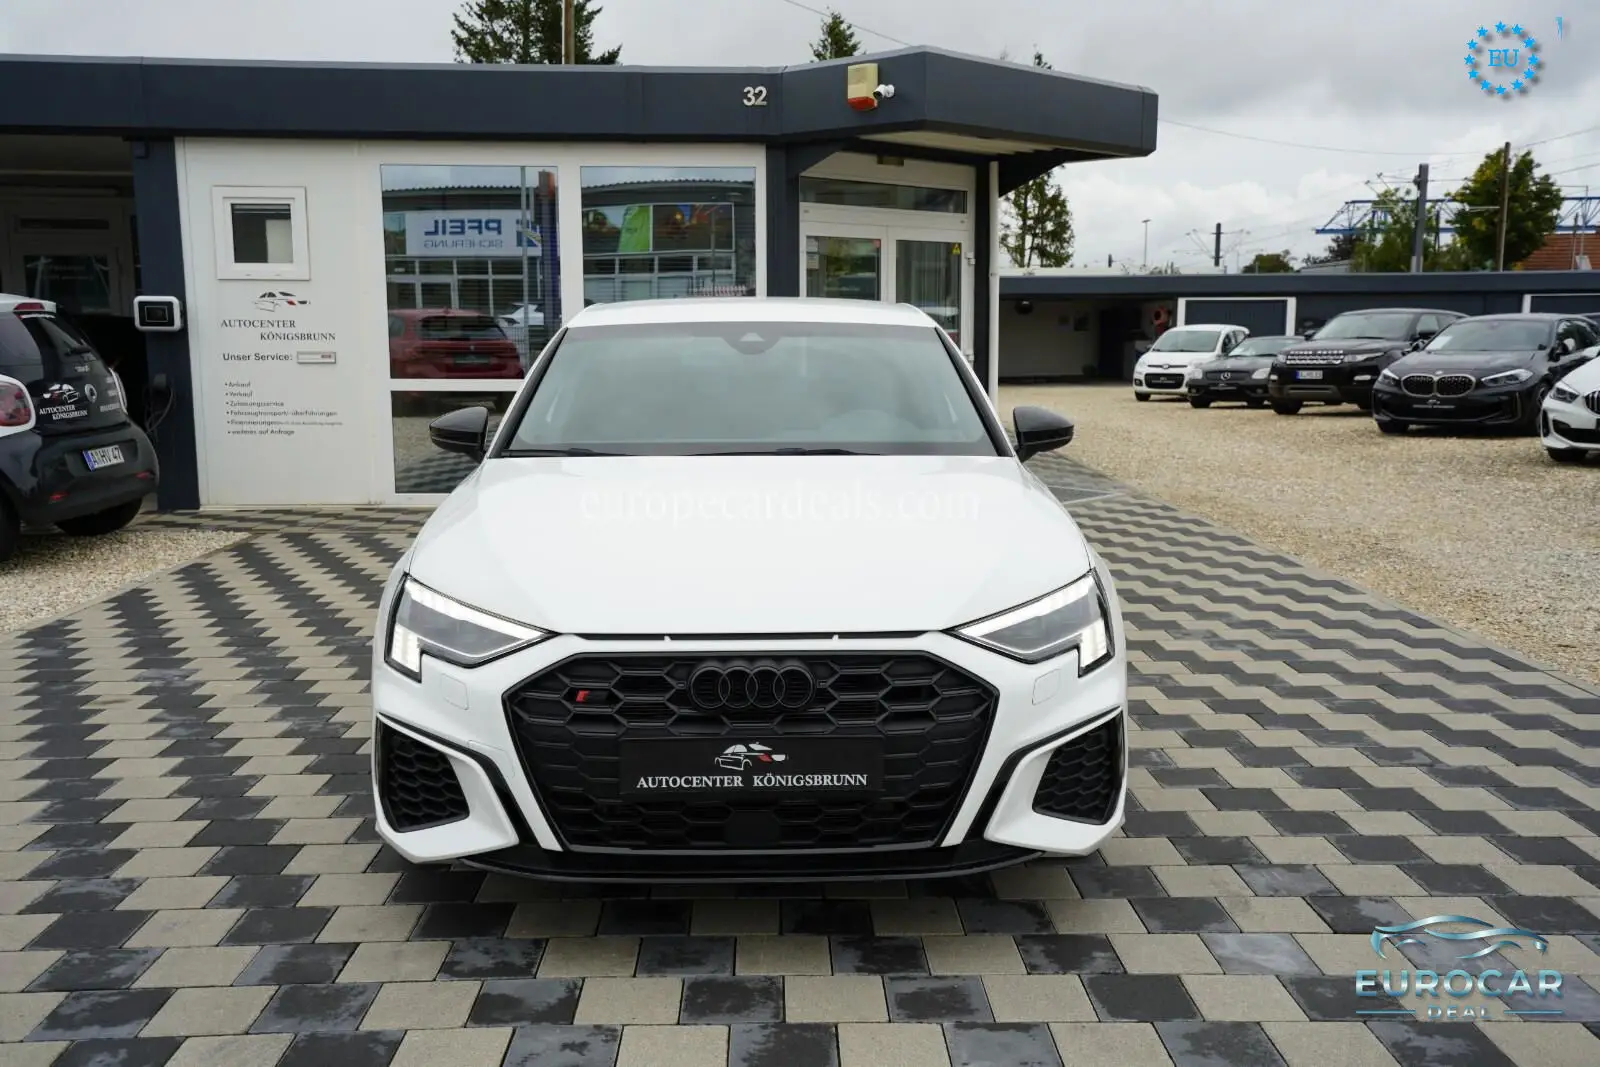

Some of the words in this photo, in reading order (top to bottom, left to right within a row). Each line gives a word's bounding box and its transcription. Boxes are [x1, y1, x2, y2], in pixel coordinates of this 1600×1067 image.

[743, 86, 767, 106] 32
[221, 319, 296, 328] AUTOCENTER
[260, 331, 336, 341] KÖNIGSBRUNN
[222, 353, 251, 361] Unser
[254, 353, 293, 361] Service:
[39, 404, 76, 415] AUTOCENTER
[52, 409, 88, 420] KÖNIGSBRUNN
[636, 775, 744, 789] AUTOCENTER
[752, 773, 868, 788] KÖNIGSBRUNN
